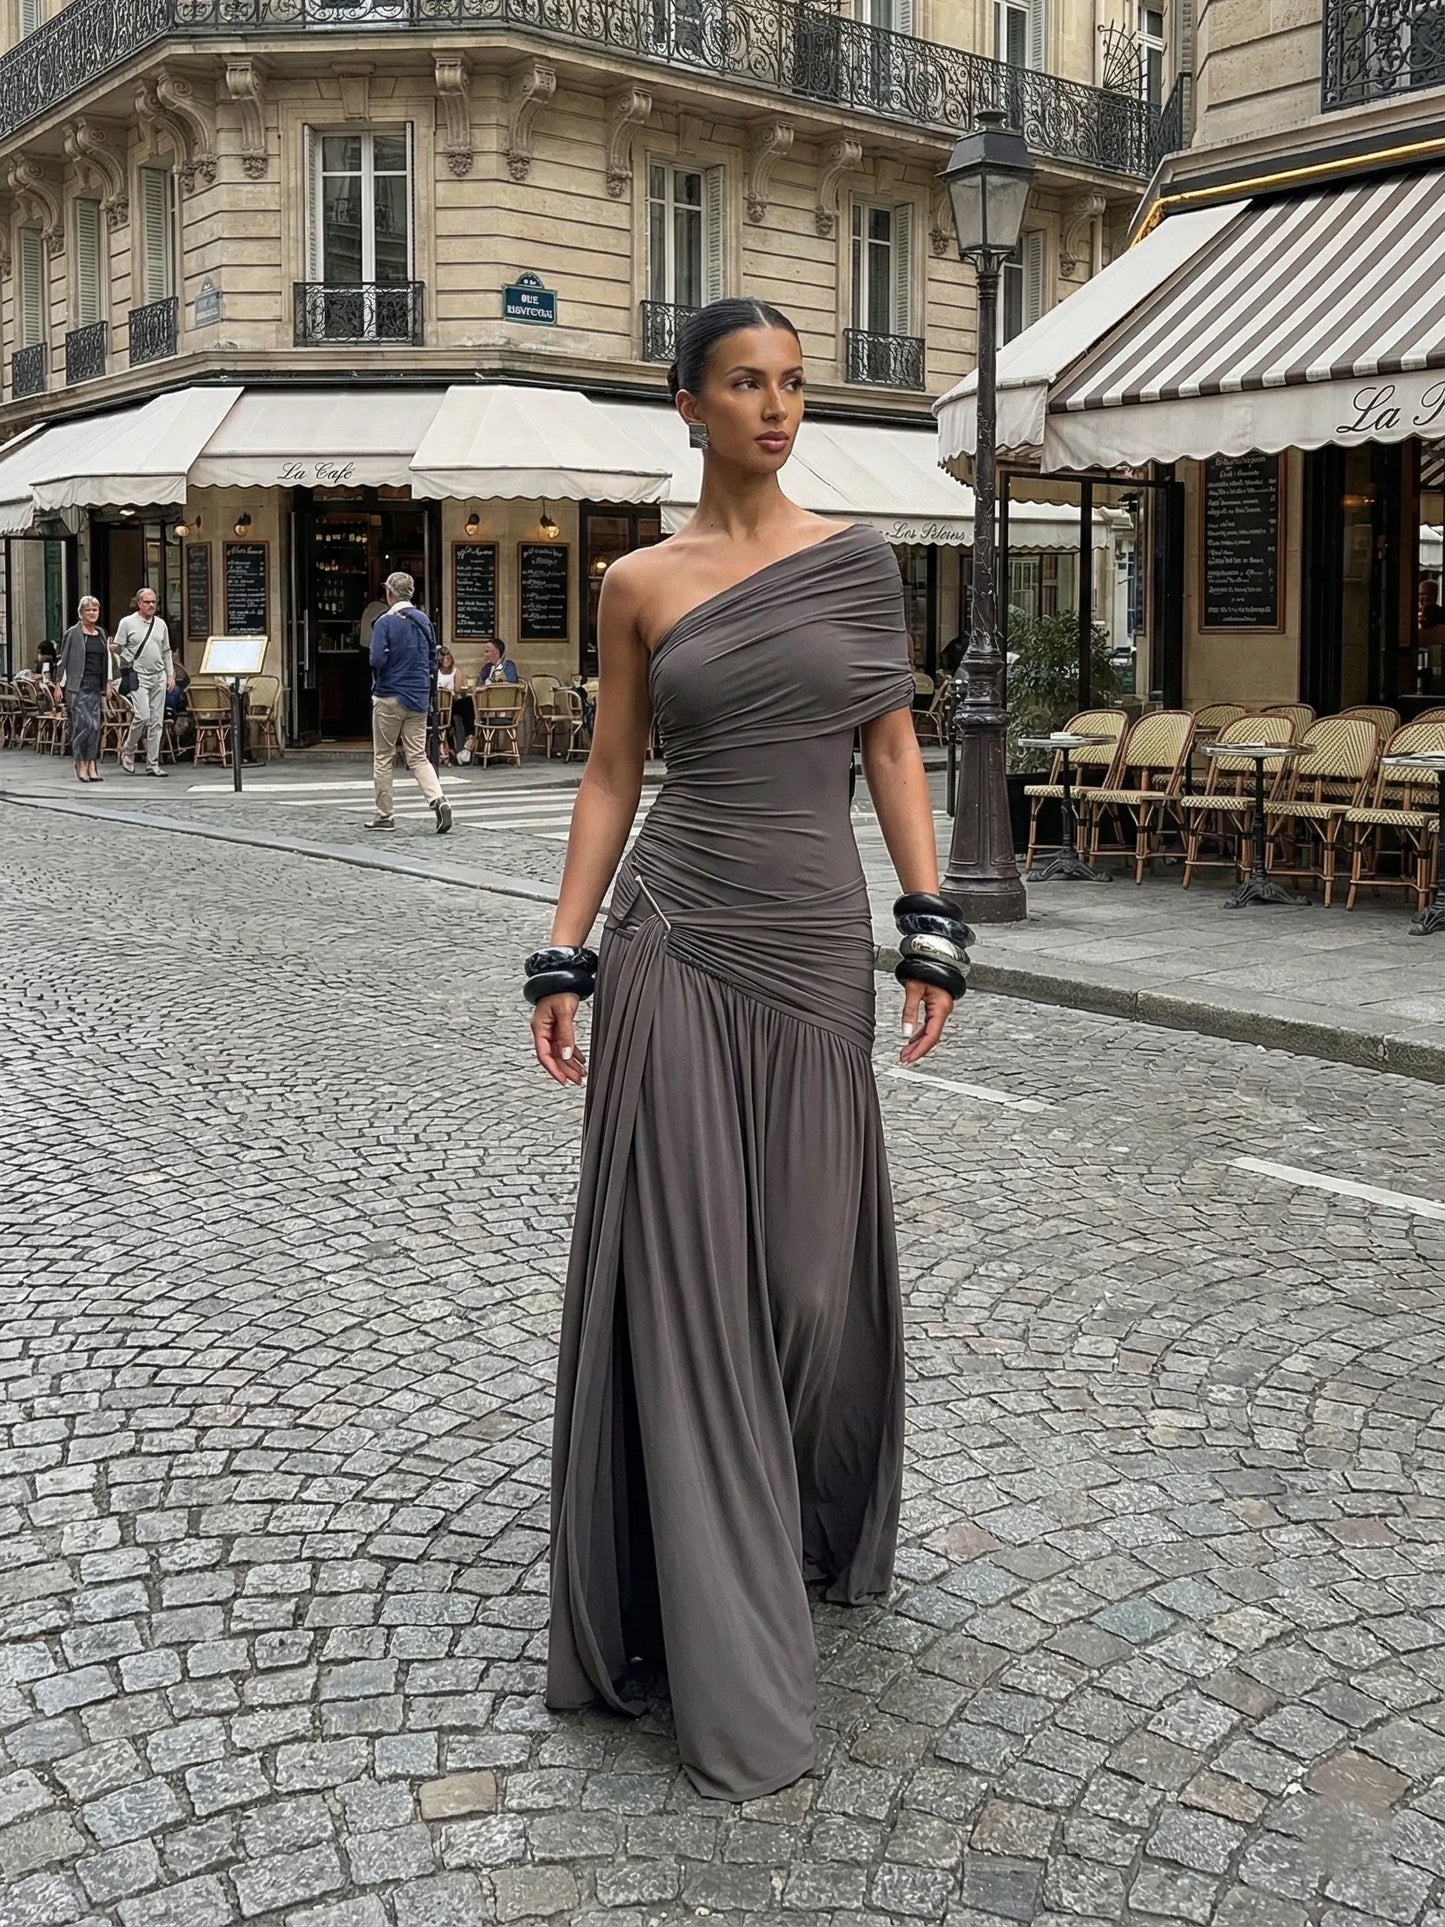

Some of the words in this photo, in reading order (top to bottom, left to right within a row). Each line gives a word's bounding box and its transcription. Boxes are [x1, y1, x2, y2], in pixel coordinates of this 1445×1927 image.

[1336, 384, 1402, 434] La
[276, 461, 307, 480] La
[314, 461, 356, 484] Café
